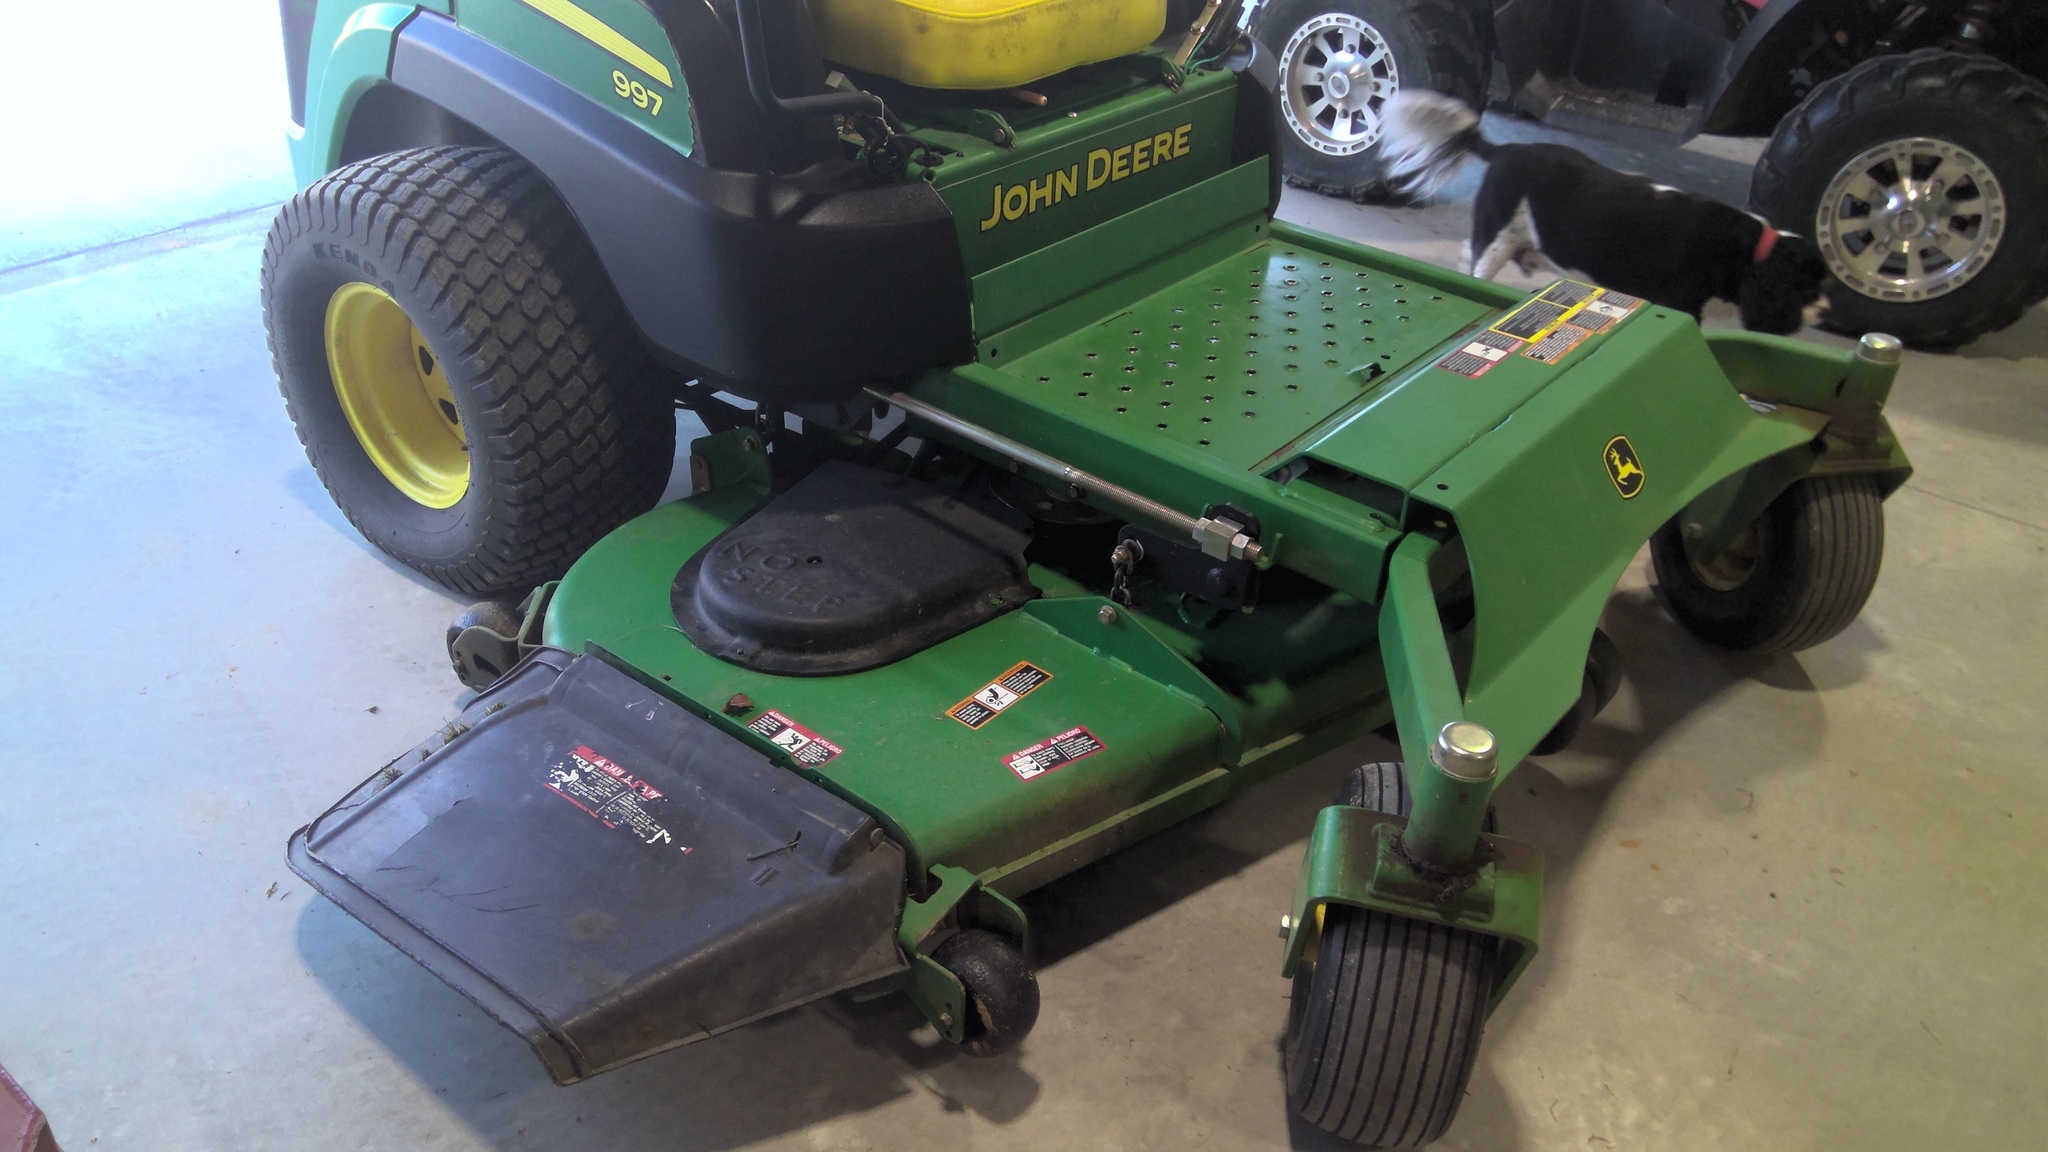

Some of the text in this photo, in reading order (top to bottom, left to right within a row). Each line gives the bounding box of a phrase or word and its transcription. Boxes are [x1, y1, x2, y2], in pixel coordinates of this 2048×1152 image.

[612, 70, 663, 116] 997
[979, 121, 1194, 233] JOHN DEERE
[311, 241, 396, 299] KENDA
[772, 711, 796, 728] DANGER
[1056, 727, 1082, 742] PELIGRO
[818, 739, 844, 755] PELIGRO
[1018, 743, 1044, 757] DANGER
